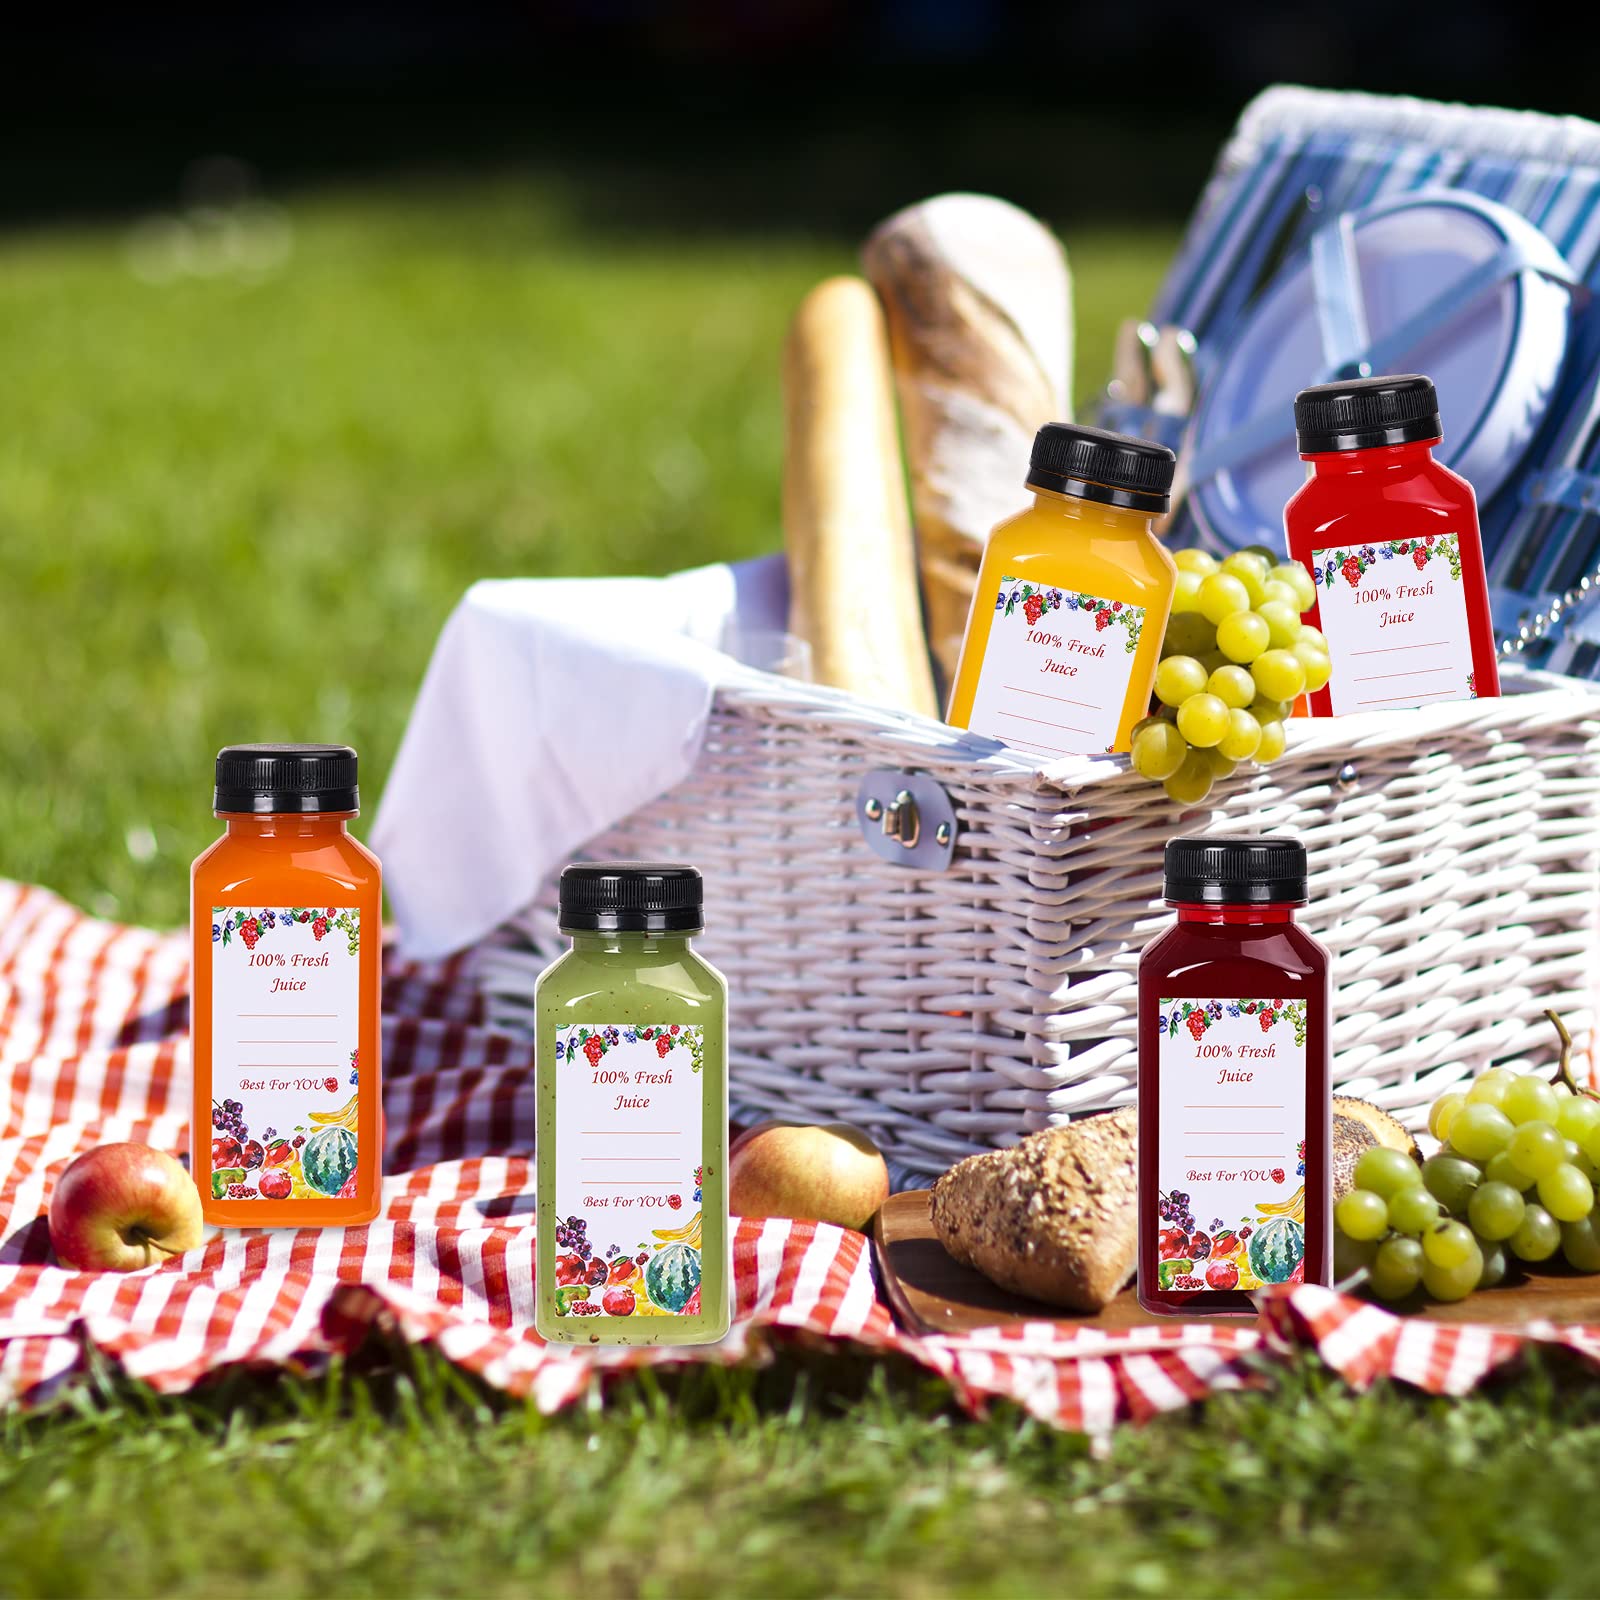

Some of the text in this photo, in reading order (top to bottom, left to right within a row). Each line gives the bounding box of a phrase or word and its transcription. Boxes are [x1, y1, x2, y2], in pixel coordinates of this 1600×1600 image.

[1353, 580, 1434, 605] 100% Fresh
[1379, 610, 1415, 628] Juice
[1024, 630, 1107, 658] 100% Fresh
[1040, 658, 1078, 677] Juice
[248, 951, 330, 968] 100% Fresh
[270, 976, 307, 994] Juice
[1195, 1042, 1277, 1059] 100% Fresh
[239, 1077, 324, 1091] Best For YOU
[592, 1068, 673, 1085] 100% Fresh
[1217, 1068, 1254, 1085] Juice
[614, 1094, 651, 1111] Juice
[1186, 1168, 1271, 1182] Best For YOU
[583, 1194, 668, 1208] Best For YOU
